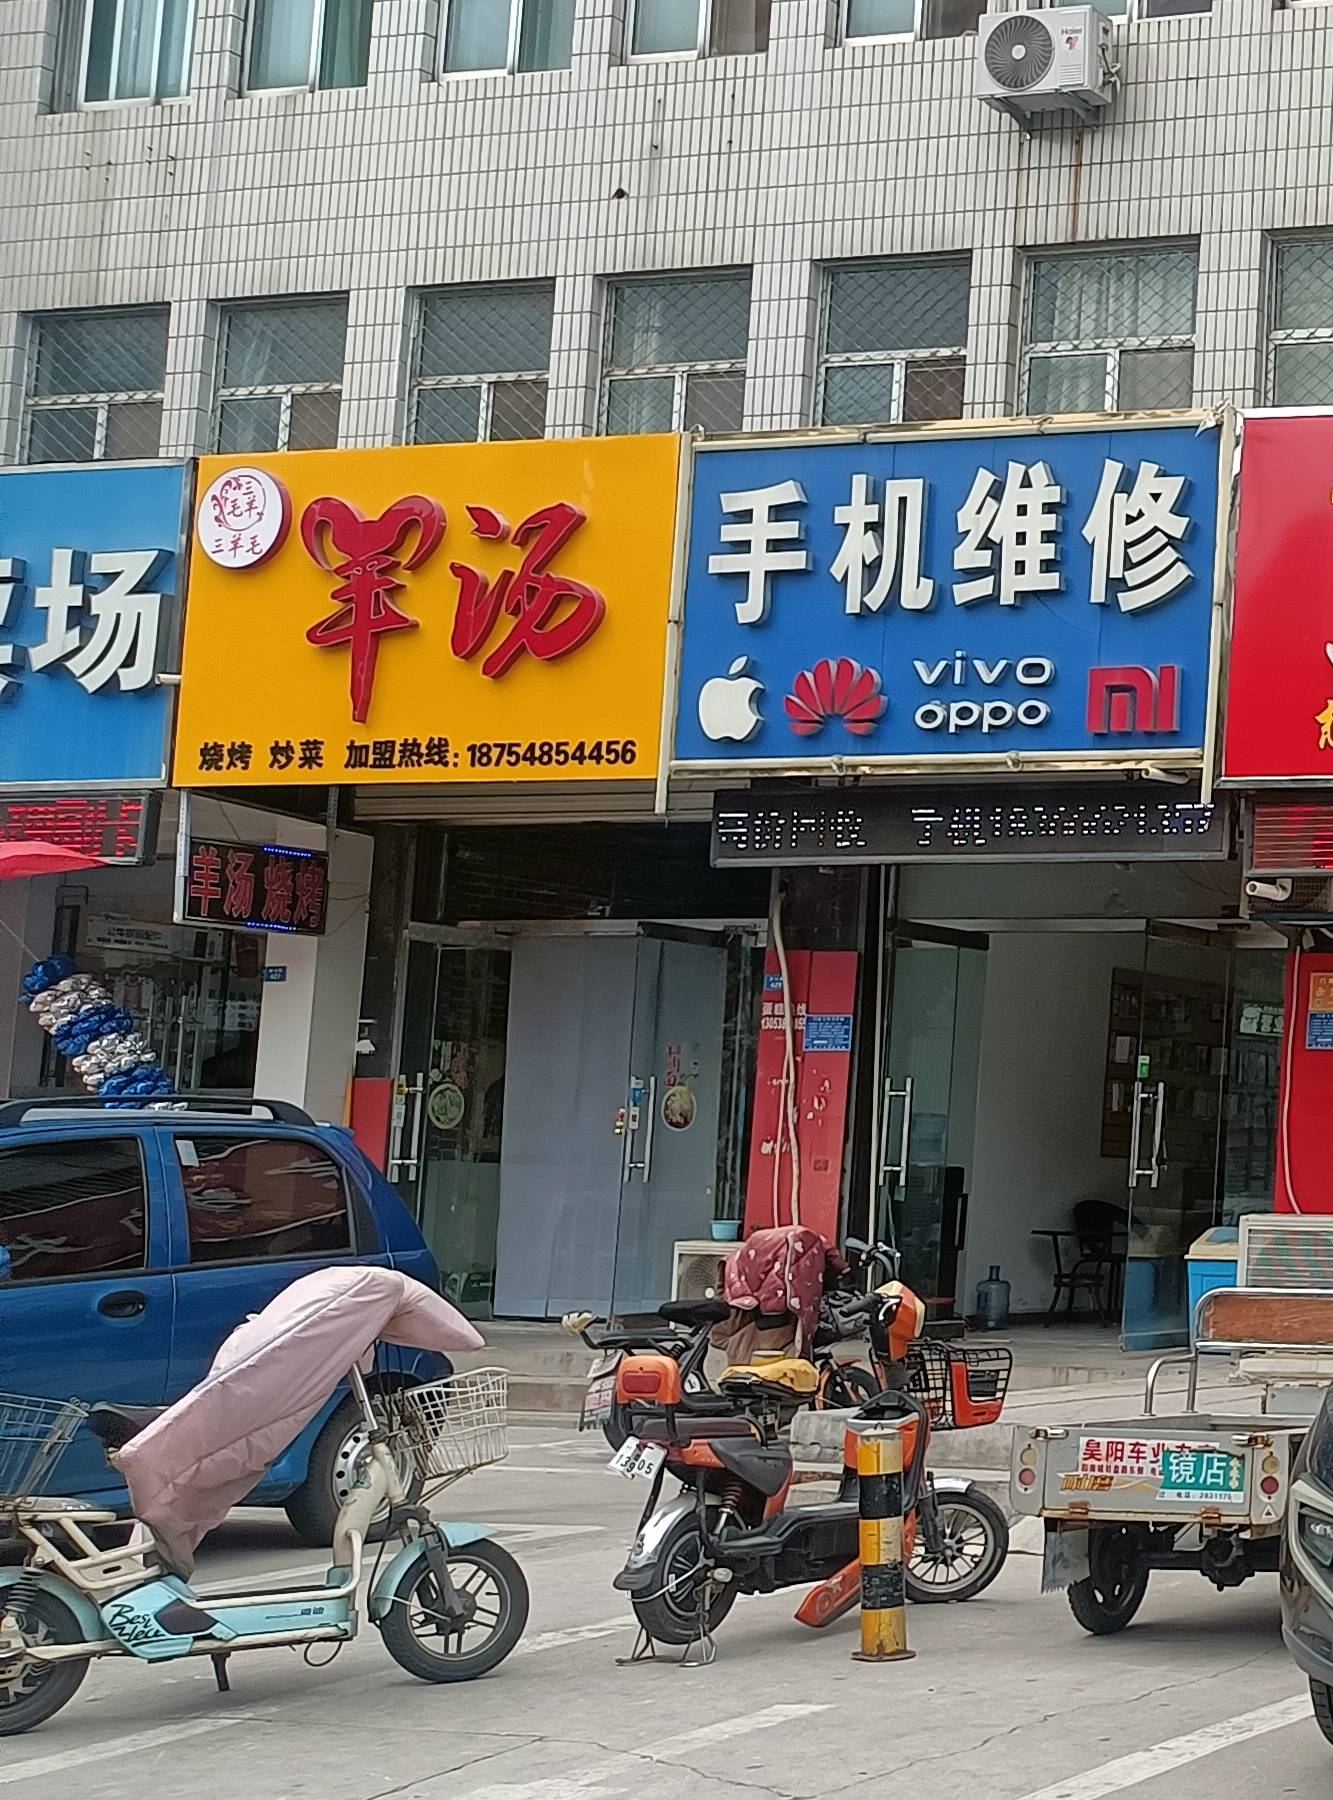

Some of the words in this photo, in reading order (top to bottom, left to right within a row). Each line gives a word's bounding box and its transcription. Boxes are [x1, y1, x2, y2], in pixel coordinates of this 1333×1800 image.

[211, 533, 263, 559] 三羊毛
[708, 457, 1198, 626] 手机维修
[0, 548, 170, 696] 场
[301, 494, 608, 724] 羊汤
[912, 650, 1056, 687] vivo
[914, 699, 1052, 734] oppo
[198, 741, 253, 771] 烧烤
[268, 739, 325, 770] 炒菜
[190, 845, 256, 919] 羊汤
[1168, 1452, 1229, 1487] 镜店
